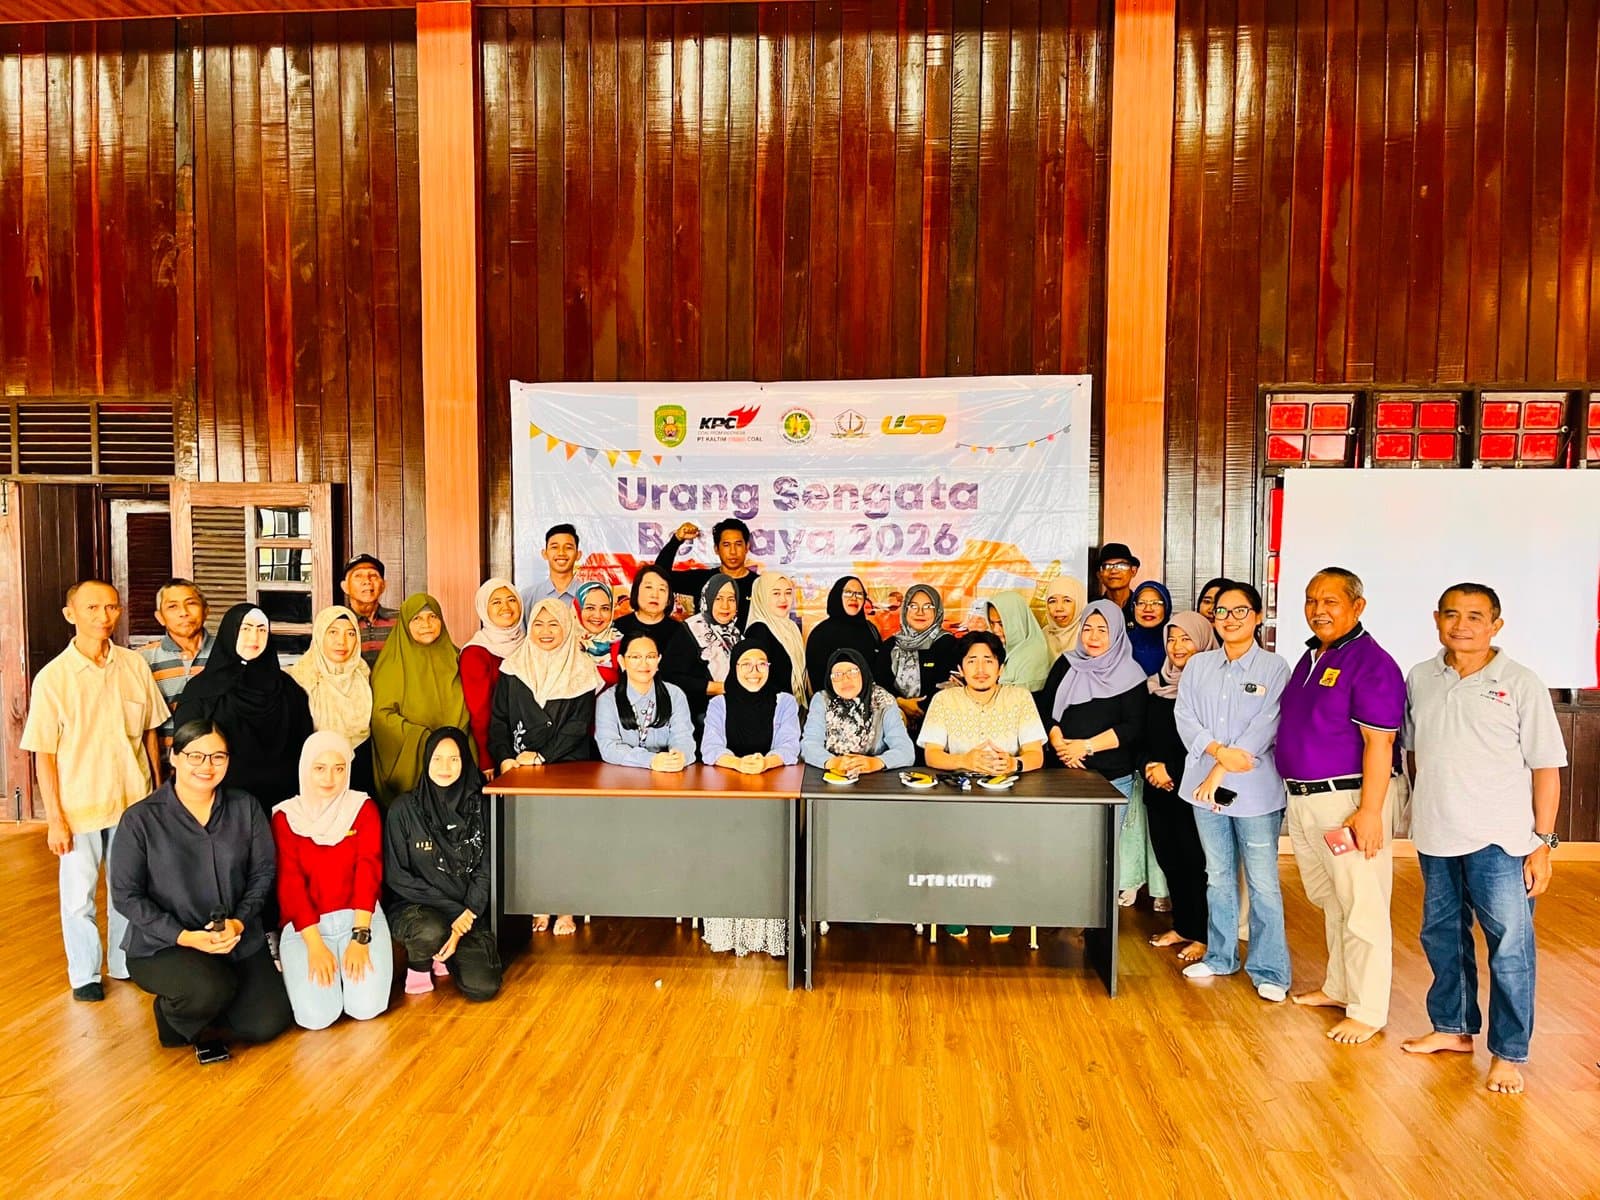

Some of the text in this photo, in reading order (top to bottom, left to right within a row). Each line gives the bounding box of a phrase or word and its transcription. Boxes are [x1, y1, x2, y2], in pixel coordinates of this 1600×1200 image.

[699, 417, 737, 430] KPC
[618, 475, 979, 520] Urang Sengata
[849, 522, 960, 556] 2026
